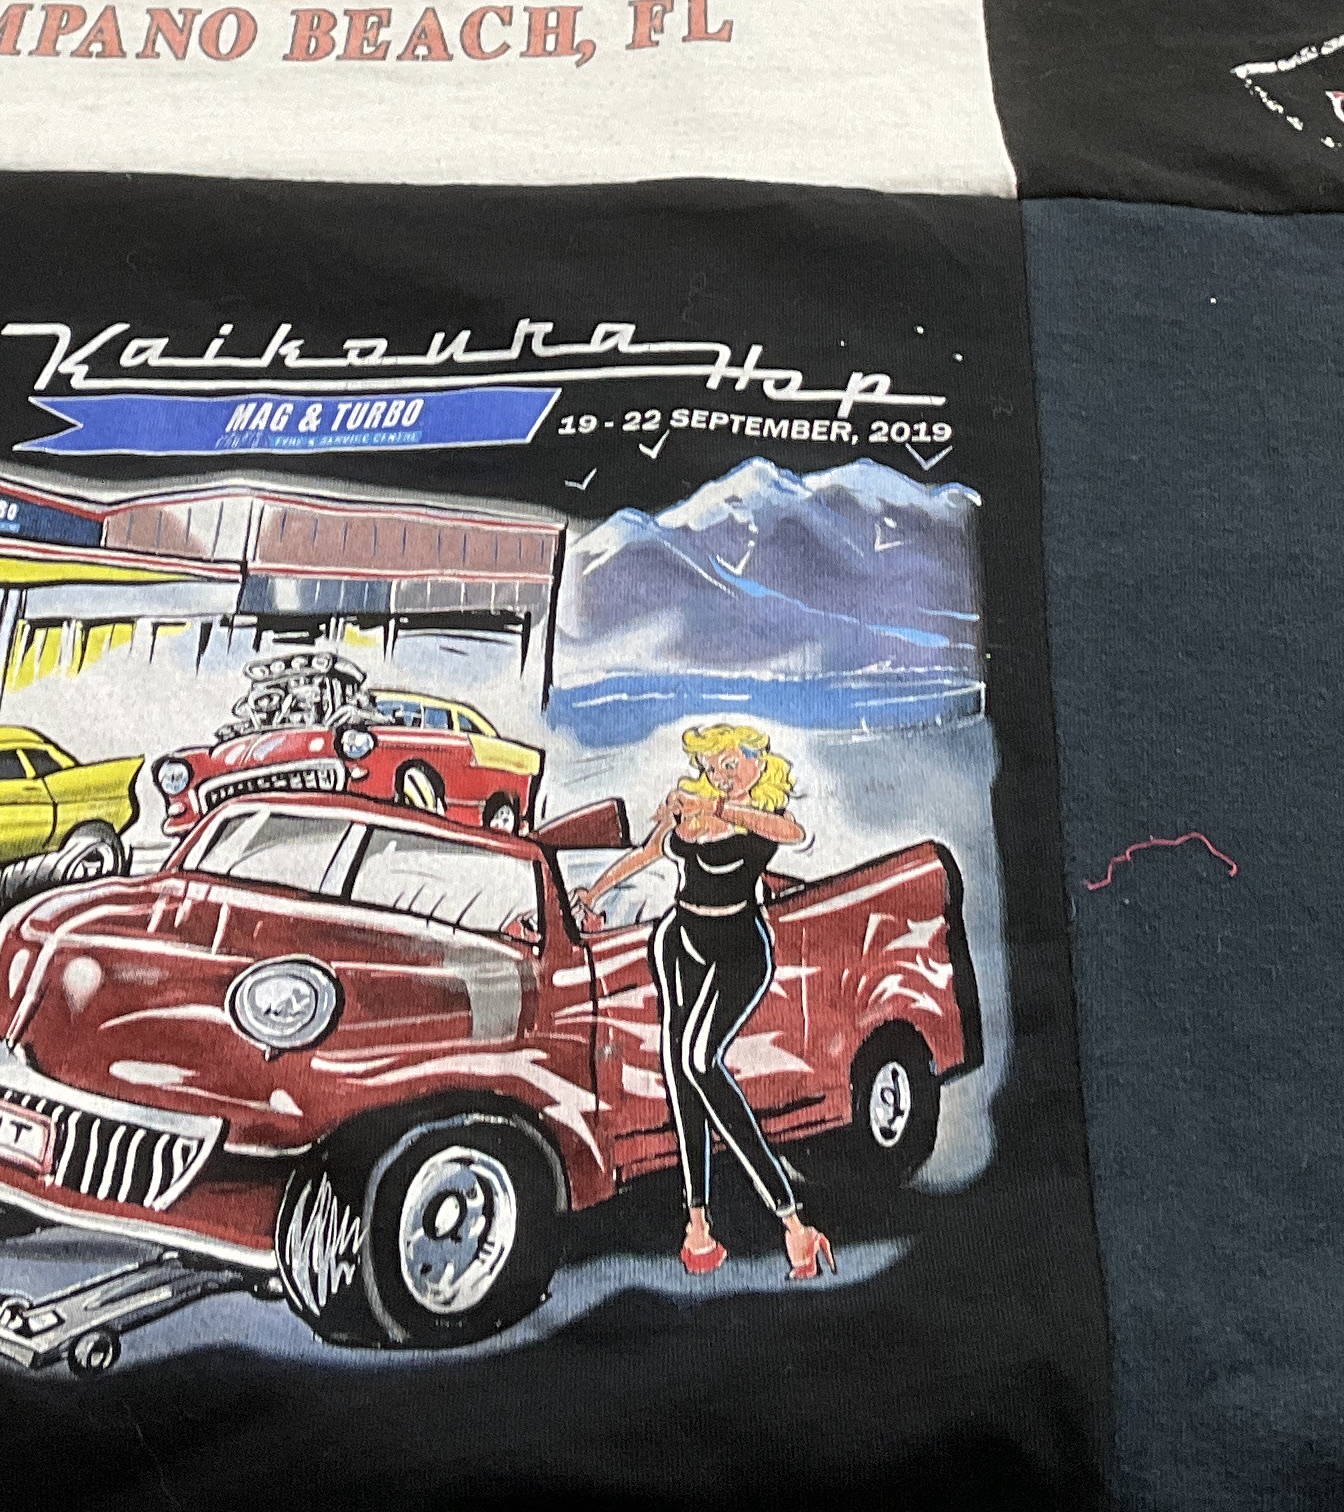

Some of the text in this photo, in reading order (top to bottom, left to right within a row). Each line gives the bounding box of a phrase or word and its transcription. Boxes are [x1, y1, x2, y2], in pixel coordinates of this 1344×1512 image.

[288, 1, 598, 70] BEACH,
[1, 317, 948, 419] Kaikoura Hop
[225, 396, 424, 435] MAG & TURBO
[558, 408, 954, 446] 19 22 SEPTEMBER, 2019
